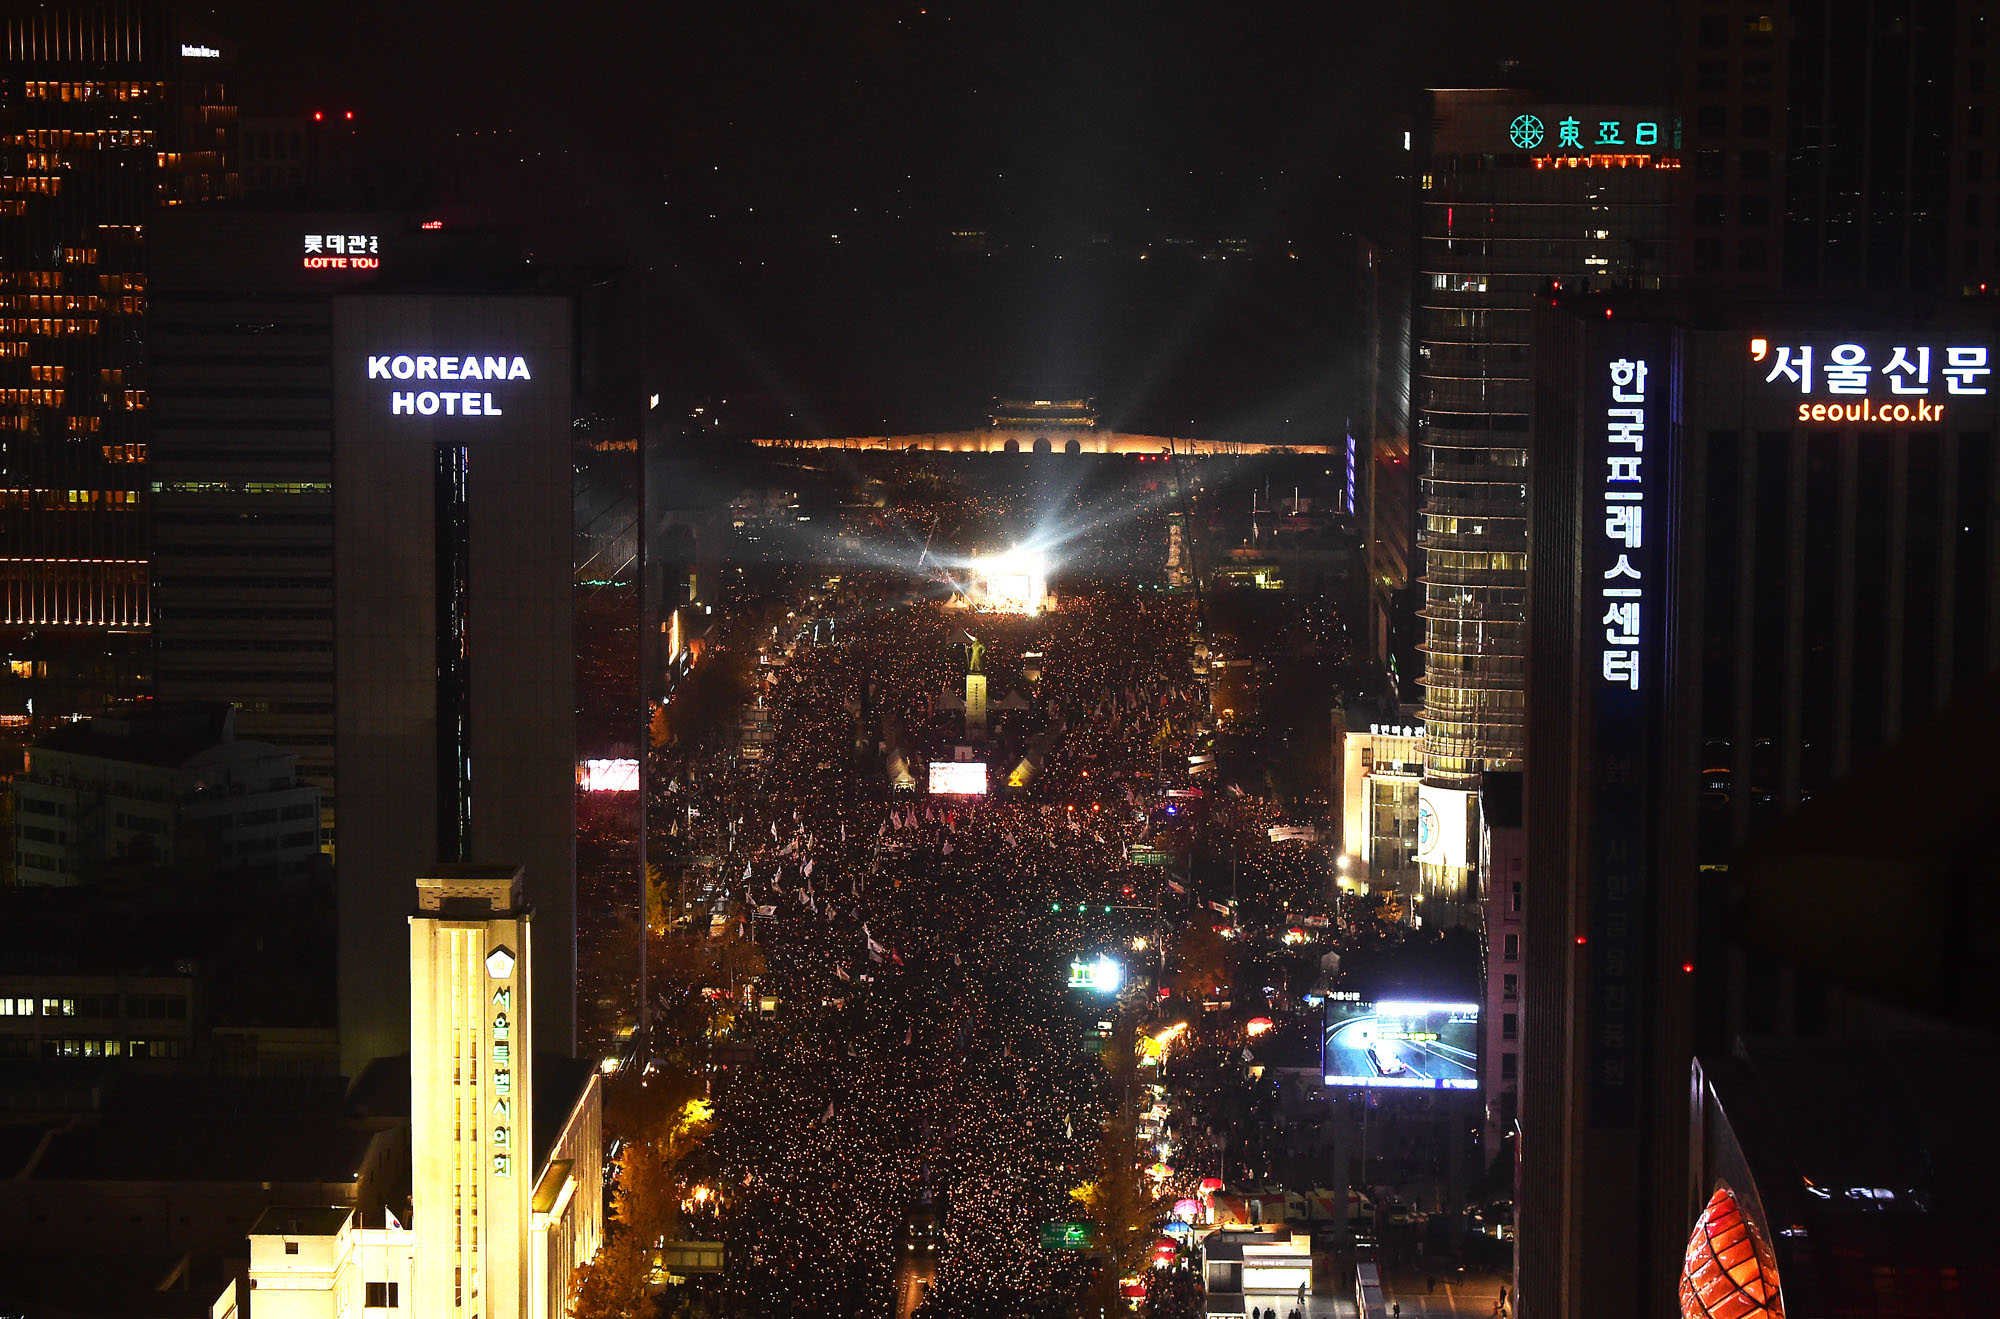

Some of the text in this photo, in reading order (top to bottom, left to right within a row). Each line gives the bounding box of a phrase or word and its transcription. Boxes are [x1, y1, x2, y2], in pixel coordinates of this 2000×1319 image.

[304, 258, 347, 268] LOTTE
[368, 355, 531, 380] KOREANA
[1765, 344, 1991, 395] 서울신문
[392, 391, 502, 416] HOTEL
[1799, 398, 1944, 422] seoul.co.kr
[1602, 359, 1647, 690] 한국프레스센터
[492, 989, 512, 1179] 서울특별시의회
